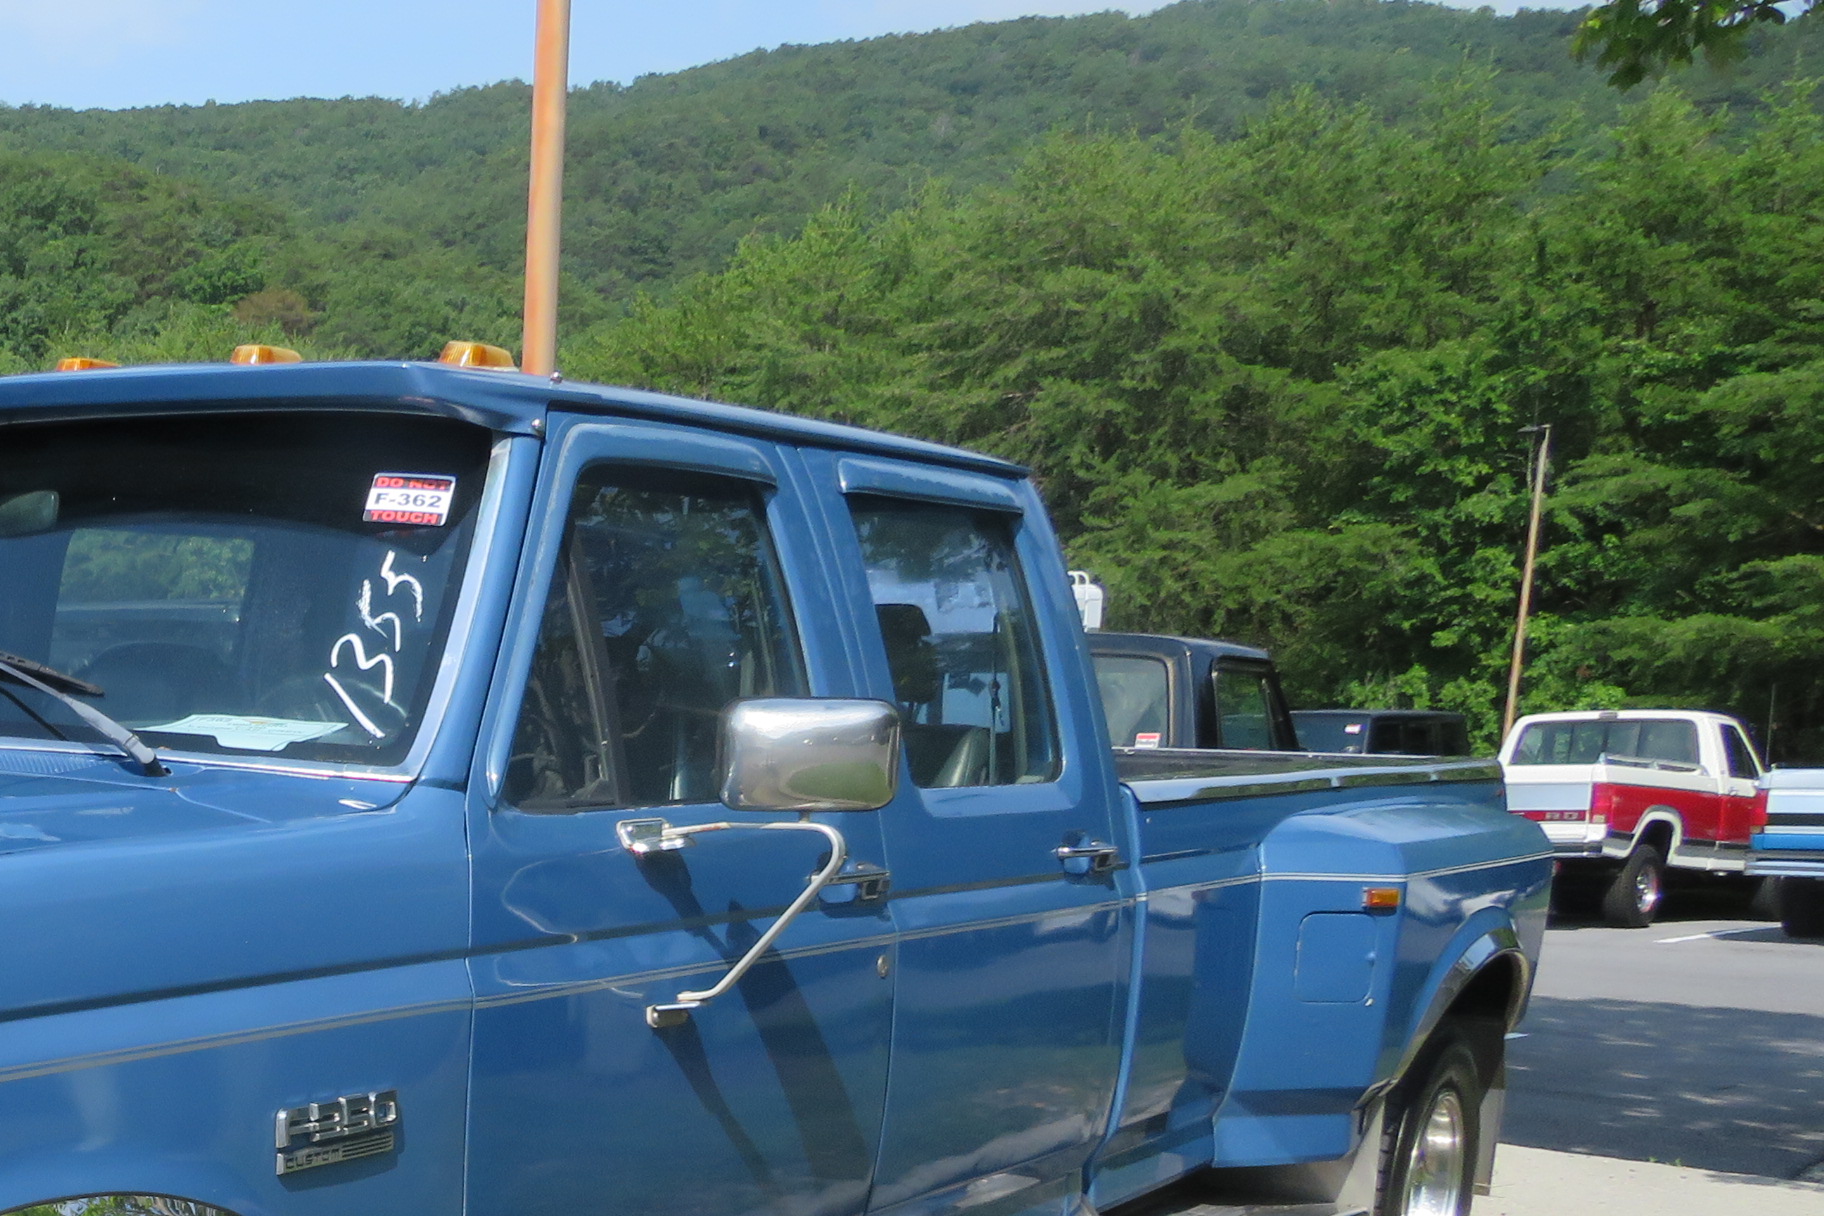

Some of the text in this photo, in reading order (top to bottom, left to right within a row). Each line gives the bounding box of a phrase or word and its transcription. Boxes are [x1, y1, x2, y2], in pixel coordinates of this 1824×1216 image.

[376, 477, 450, 491] DO NOT
[374, 492, 443, 508] F-362
[371, 510, 439, 524] TOUCH
[324, 550, 423, 739] 1355
[286, 1149, 342, 1169] CUSTOM
